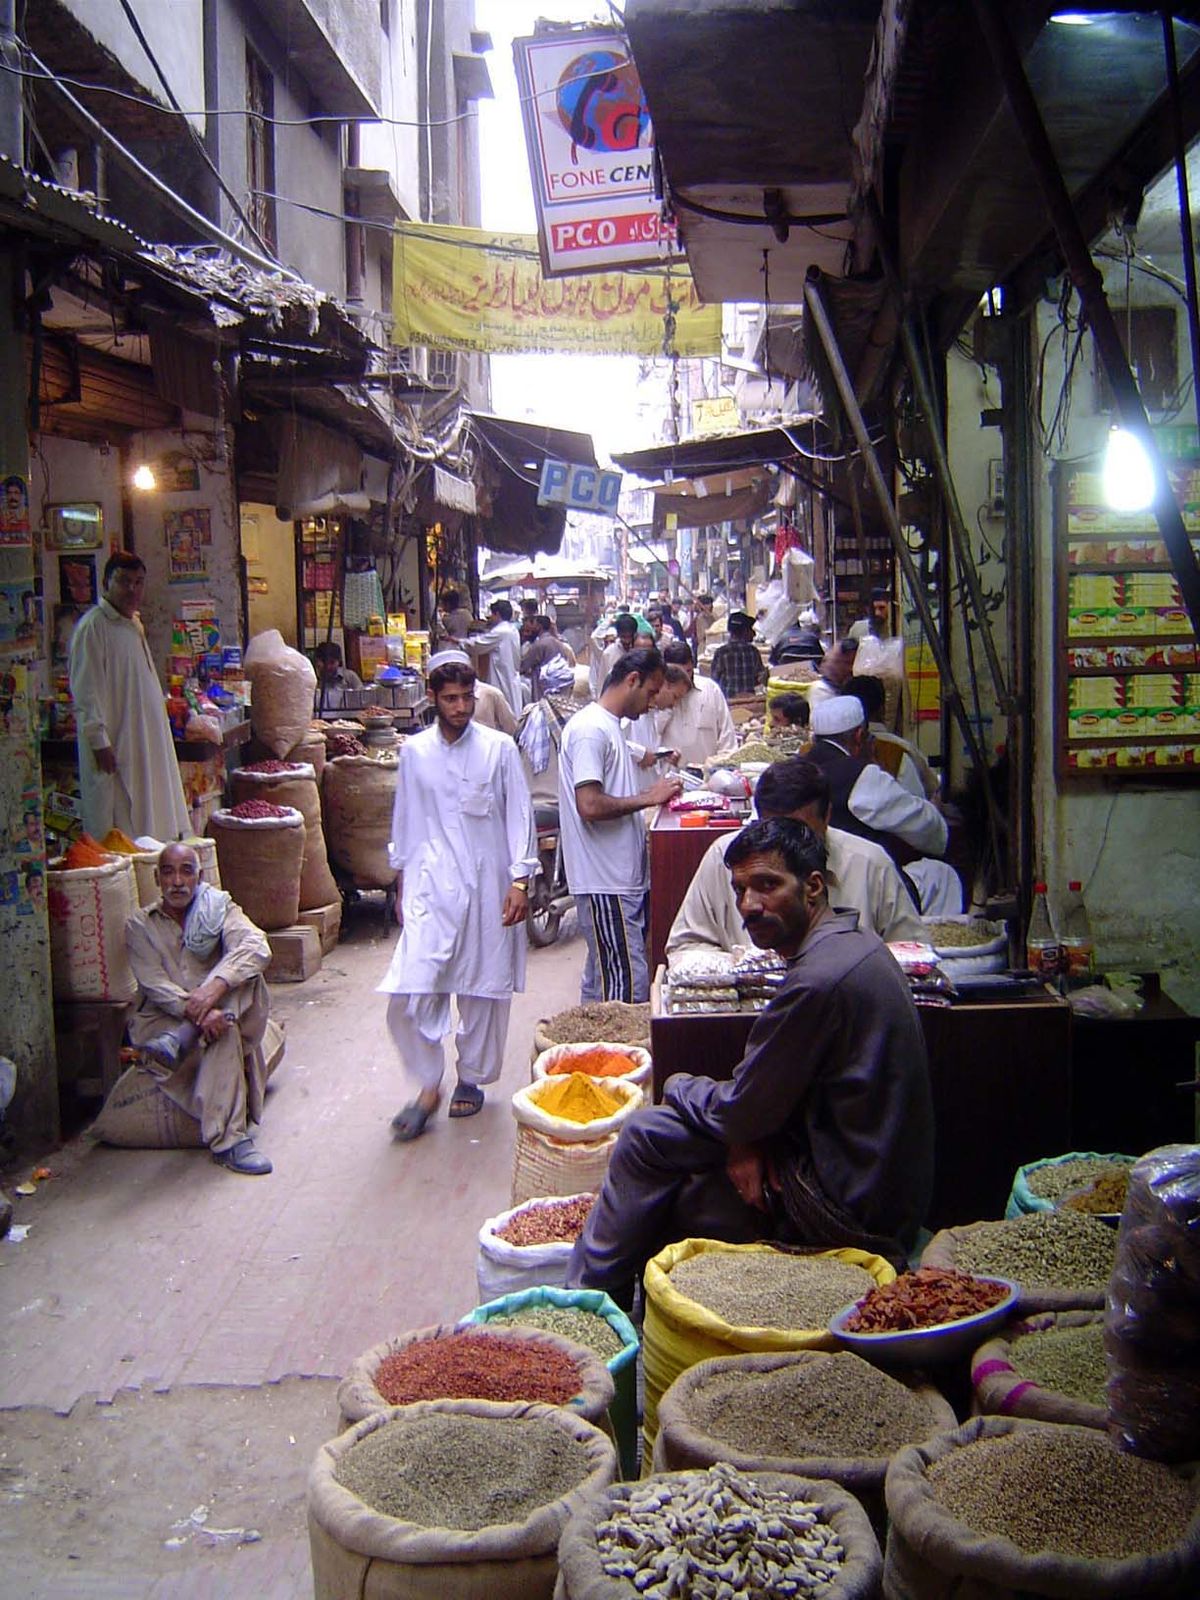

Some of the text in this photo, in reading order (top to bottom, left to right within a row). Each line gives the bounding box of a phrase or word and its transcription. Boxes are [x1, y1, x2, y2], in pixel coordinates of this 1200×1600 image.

[550, 169, 606, 190] FONE
[556, 220, 617, 250] P.C.O
[543, 463, 620, 506] PCO
